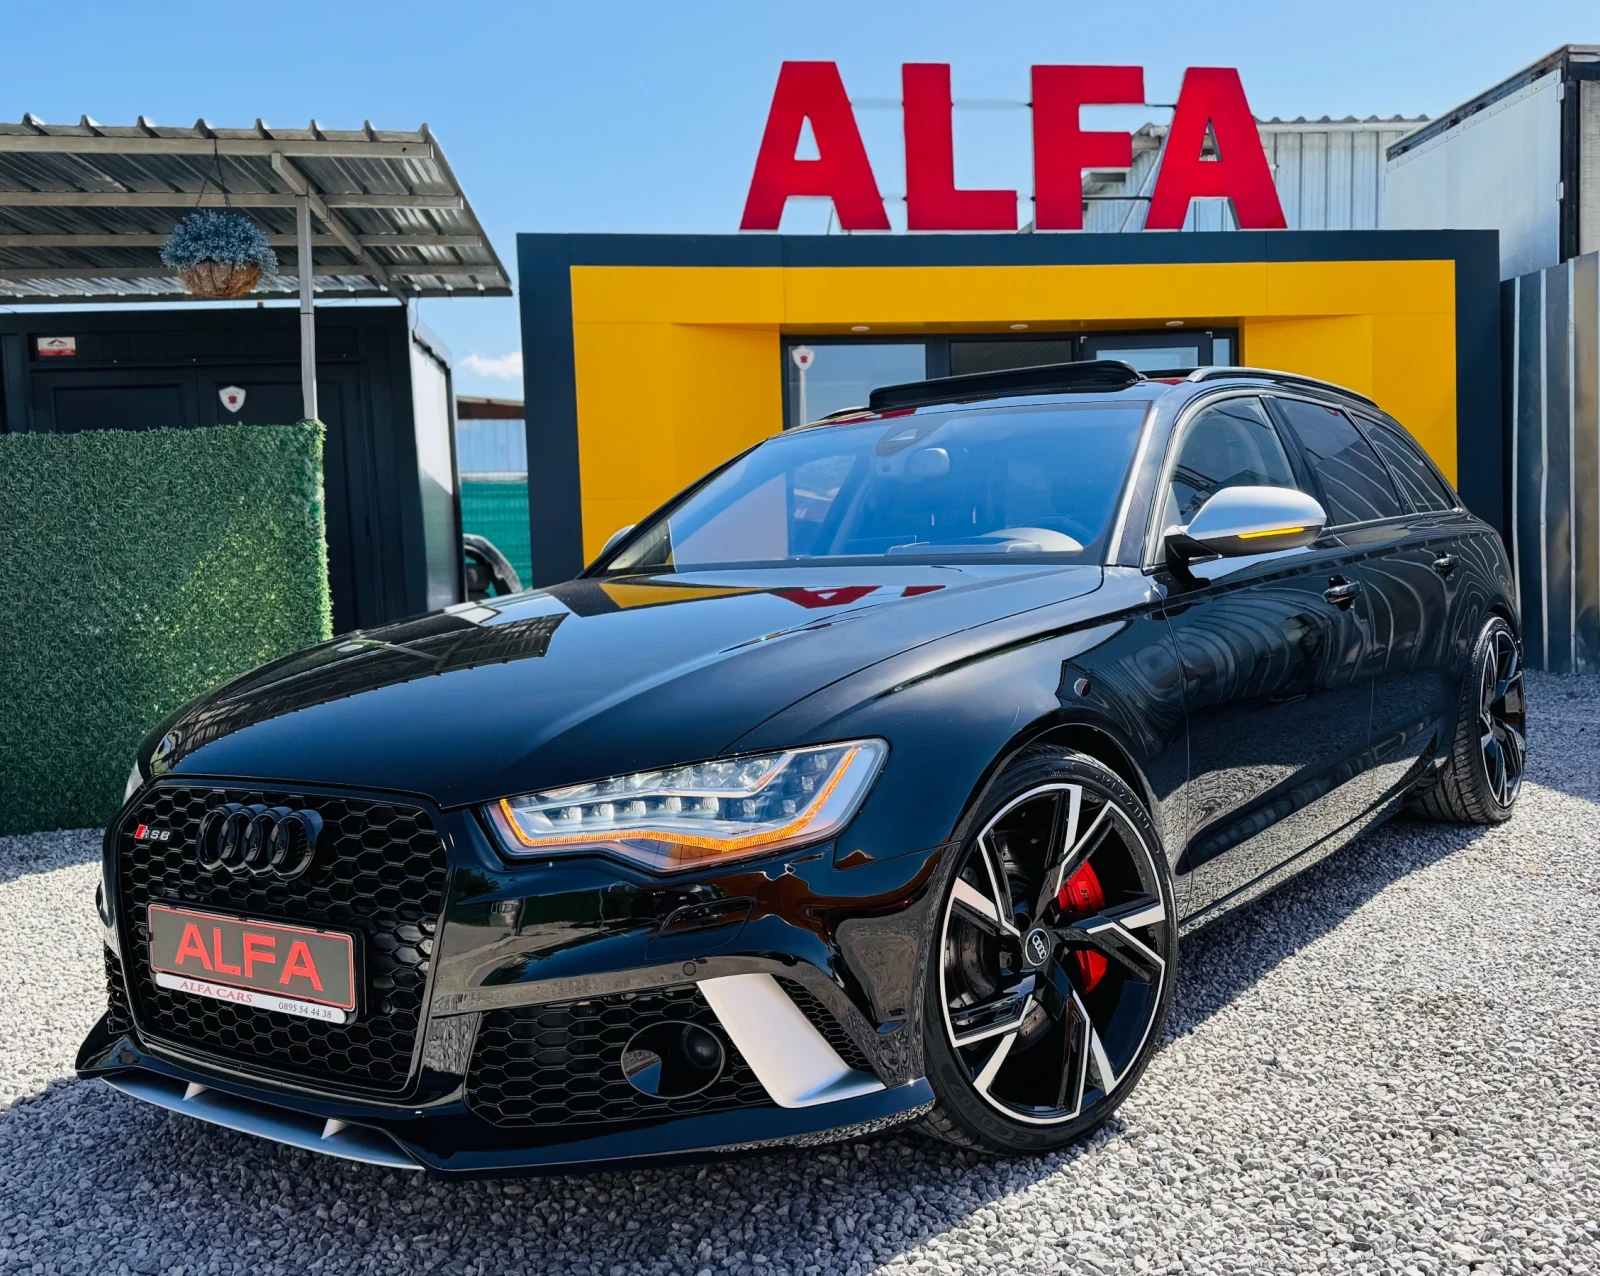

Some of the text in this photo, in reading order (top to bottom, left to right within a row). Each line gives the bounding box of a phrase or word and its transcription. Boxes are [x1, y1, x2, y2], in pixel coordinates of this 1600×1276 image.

[739, 60, 1288, 231] ALFA
[175, 922, 324, 992] ALFA
[180, 980, 253, 1004] ALFA CARS
[278, 1001, 332, 1019] 0895 54 44 38
